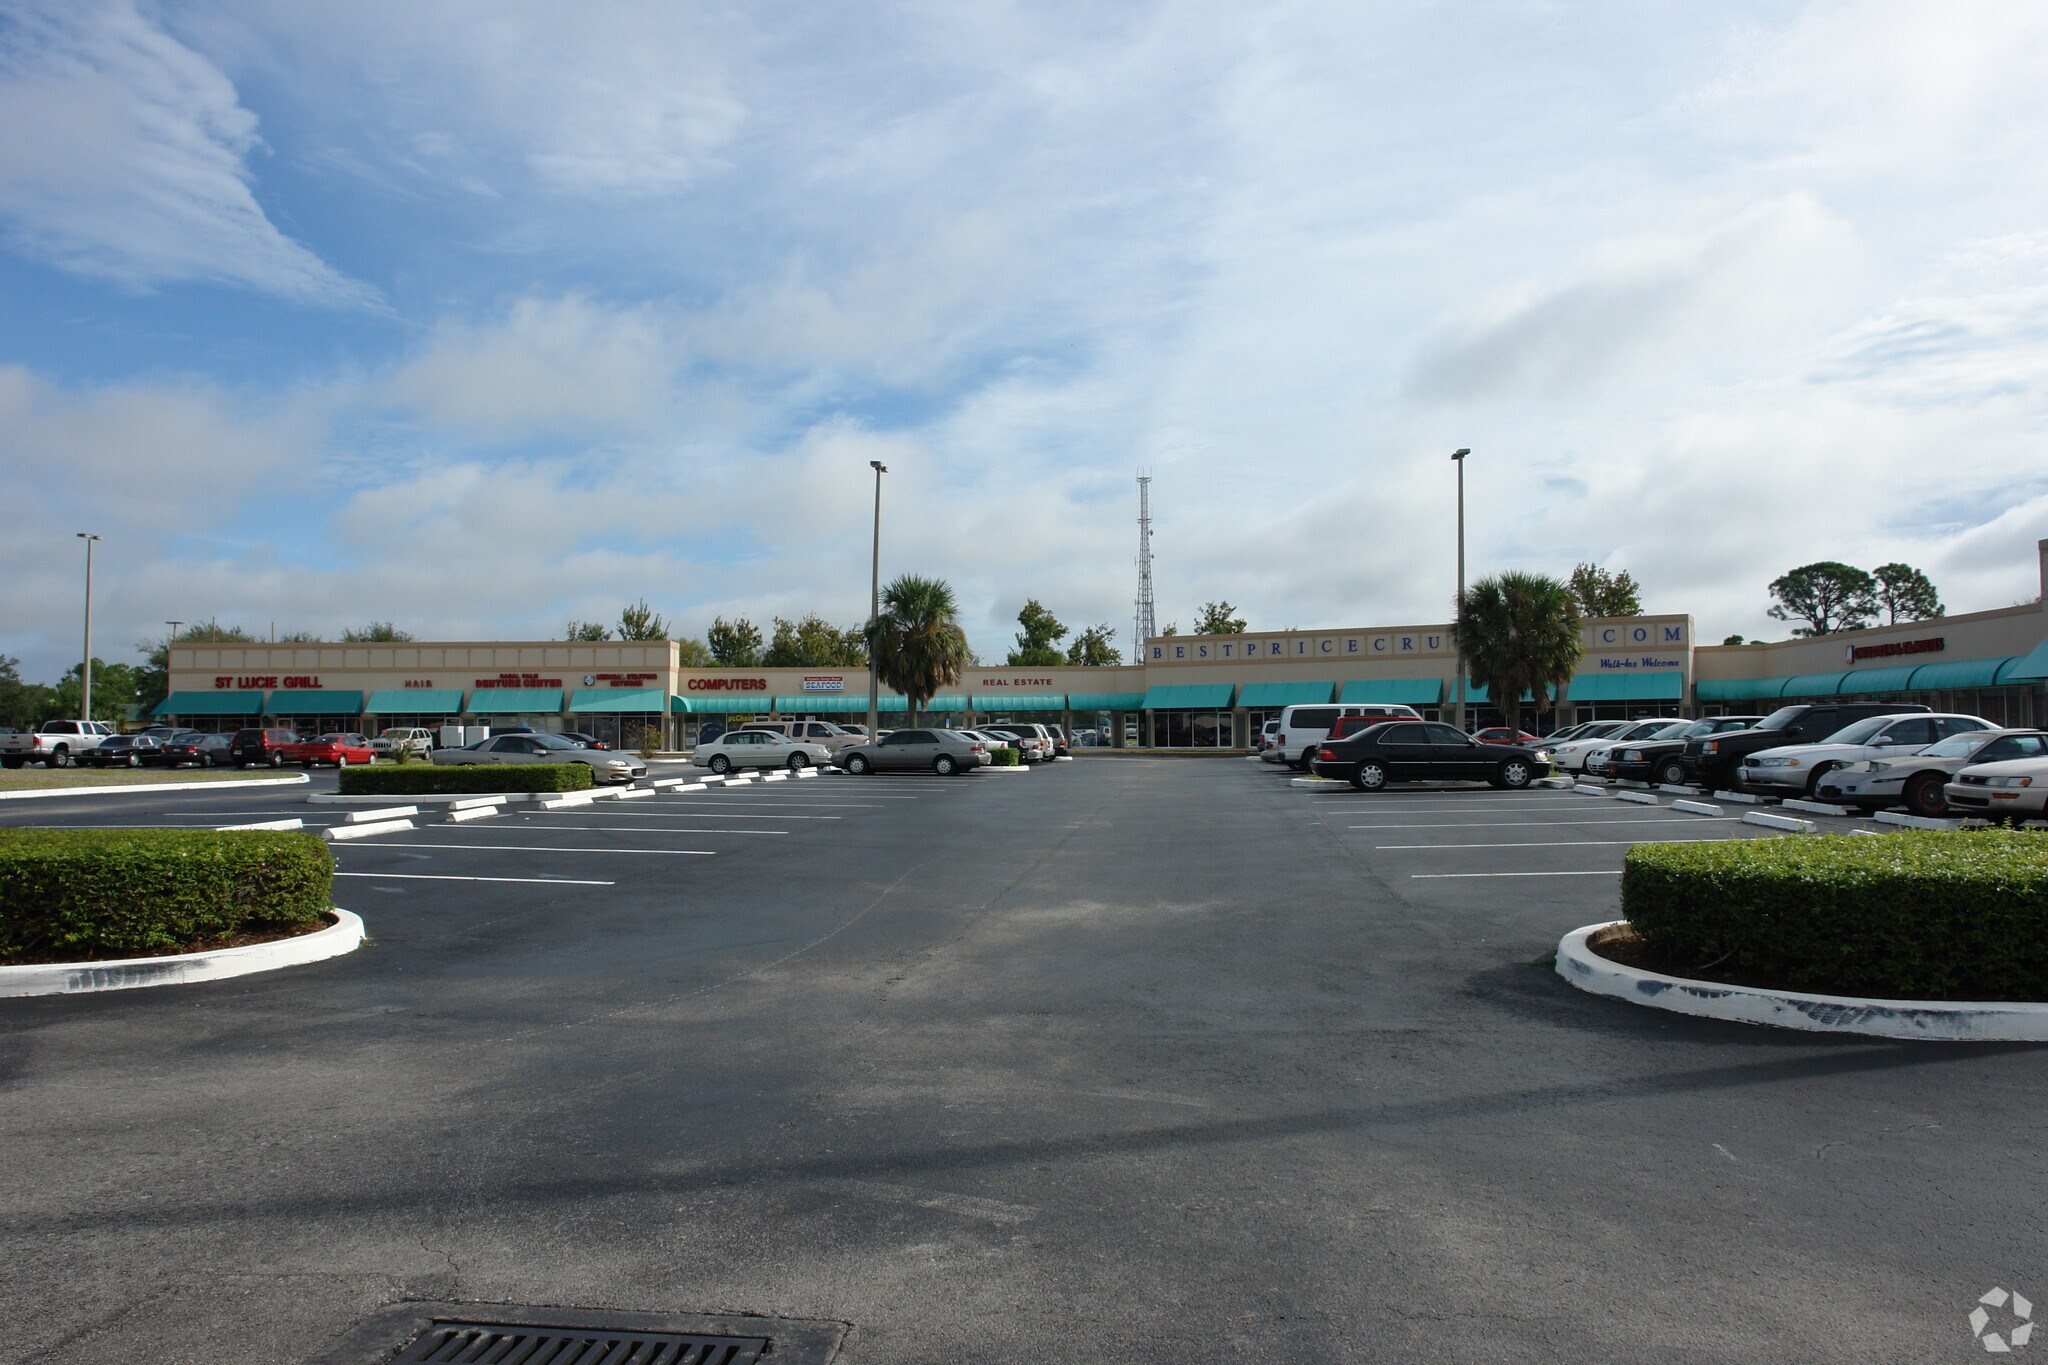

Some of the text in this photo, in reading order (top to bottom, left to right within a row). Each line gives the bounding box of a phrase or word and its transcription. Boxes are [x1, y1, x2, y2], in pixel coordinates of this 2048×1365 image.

[1600, 657, 1680, 669] Walk-Ins Welcome
[215, 676, 323, 689] ST LUCIE GRILL
[404, 680, 433, 688] HAIR
[523, 679, 563, 688] CENTER
[687, 678, 767, 690] COMPUTERS
[805, 681, 842, 689] SEAFOOD
[1014, 678, 1053, 686] ESTATE
